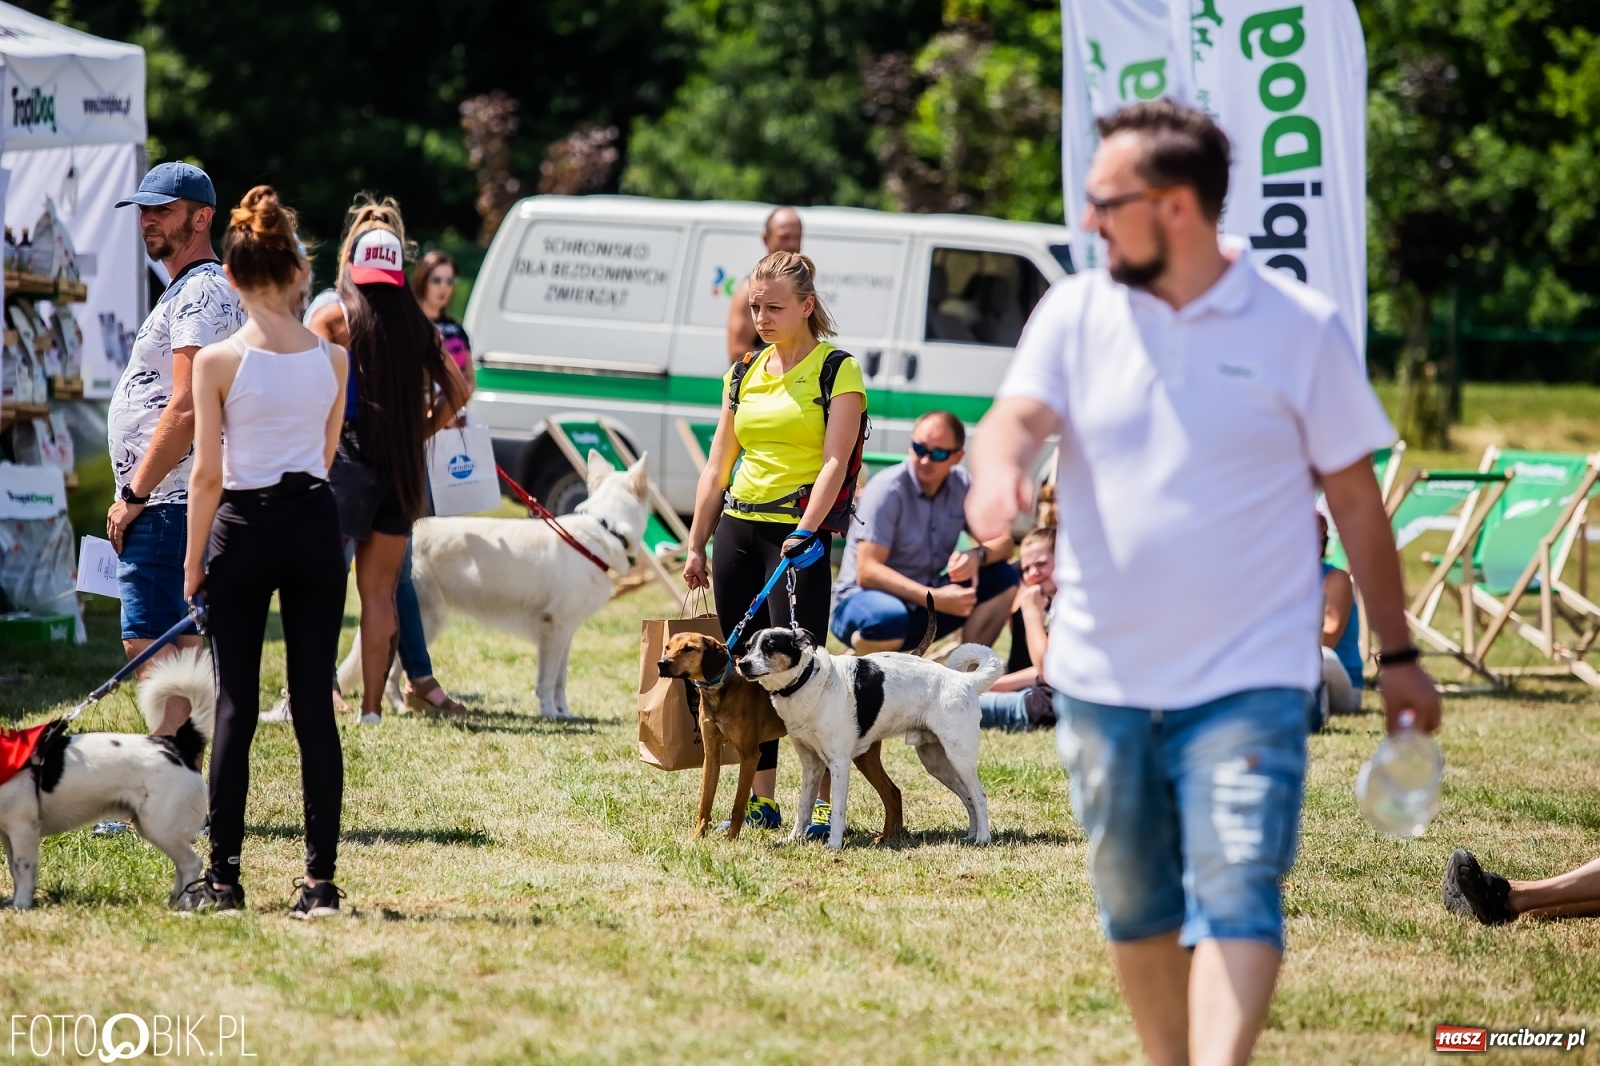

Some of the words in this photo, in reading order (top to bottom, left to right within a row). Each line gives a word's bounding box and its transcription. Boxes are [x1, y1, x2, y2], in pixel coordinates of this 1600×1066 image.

[364, 246, 397, 266] BULLS
[543, 235, 650, 262] SCHRONISKO
[514, 256, 546, 276] DLA
[552, 260, 668, 287] BEZDOMNYCH
